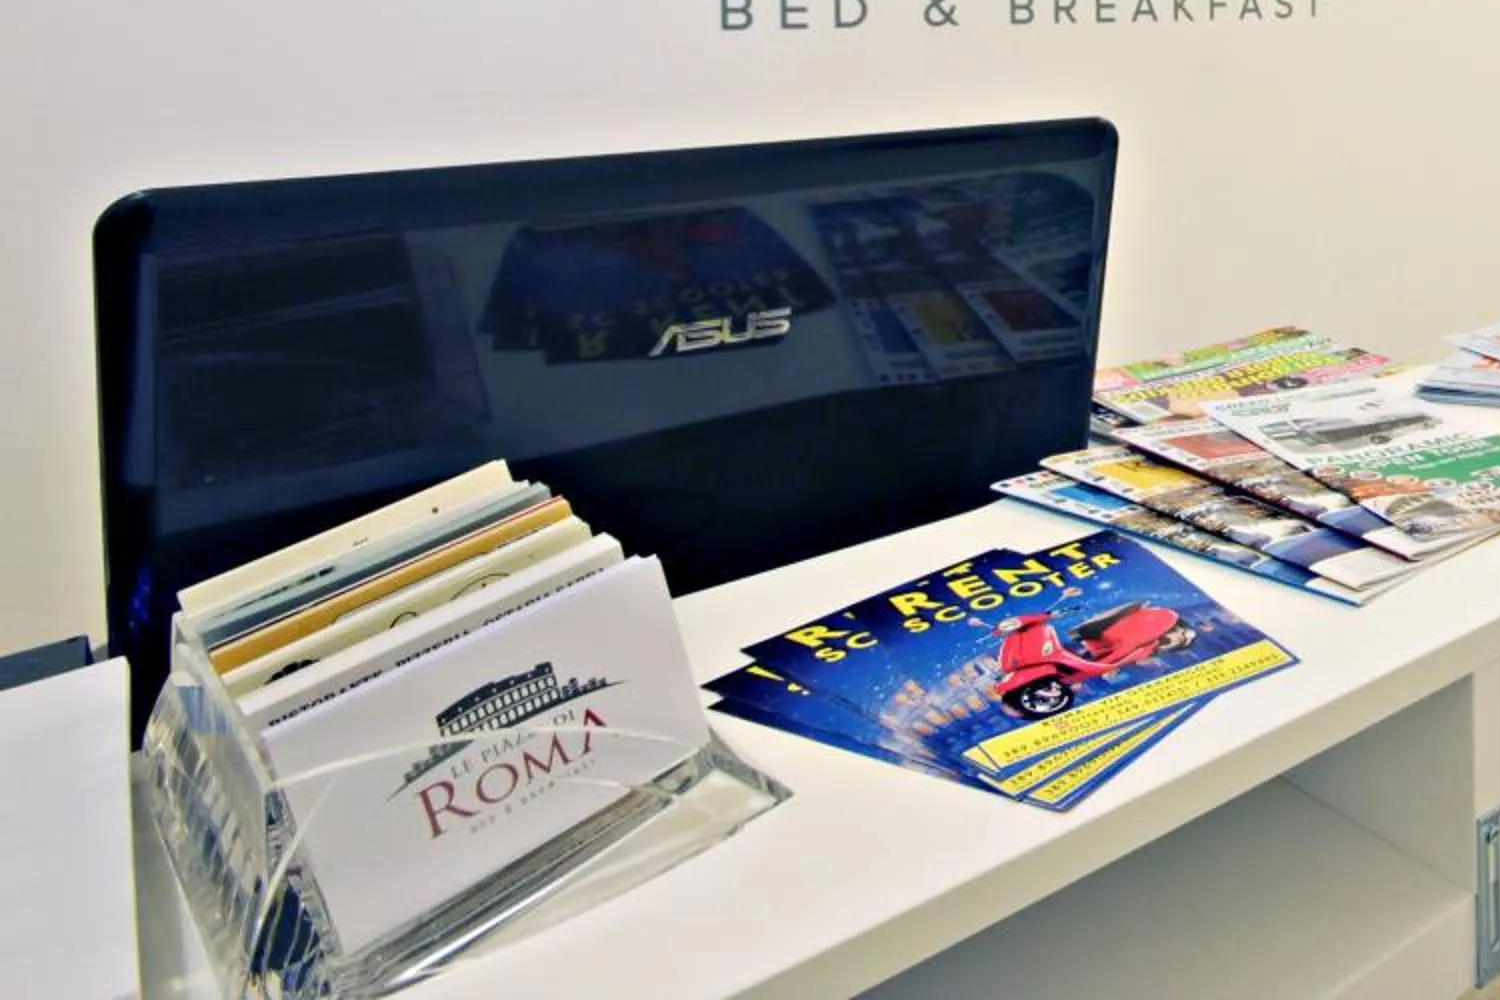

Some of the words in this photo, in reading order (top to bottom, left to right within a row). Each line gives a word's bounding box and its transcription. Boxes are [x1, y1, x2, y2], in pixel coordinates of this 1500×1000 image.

[648, 306, 792, 357] ASUS
[888, 541, 1087, 617] RENT
[903, 552, 1121, 633] SCOOTER
[418, 707, 608, 840] ROMA
